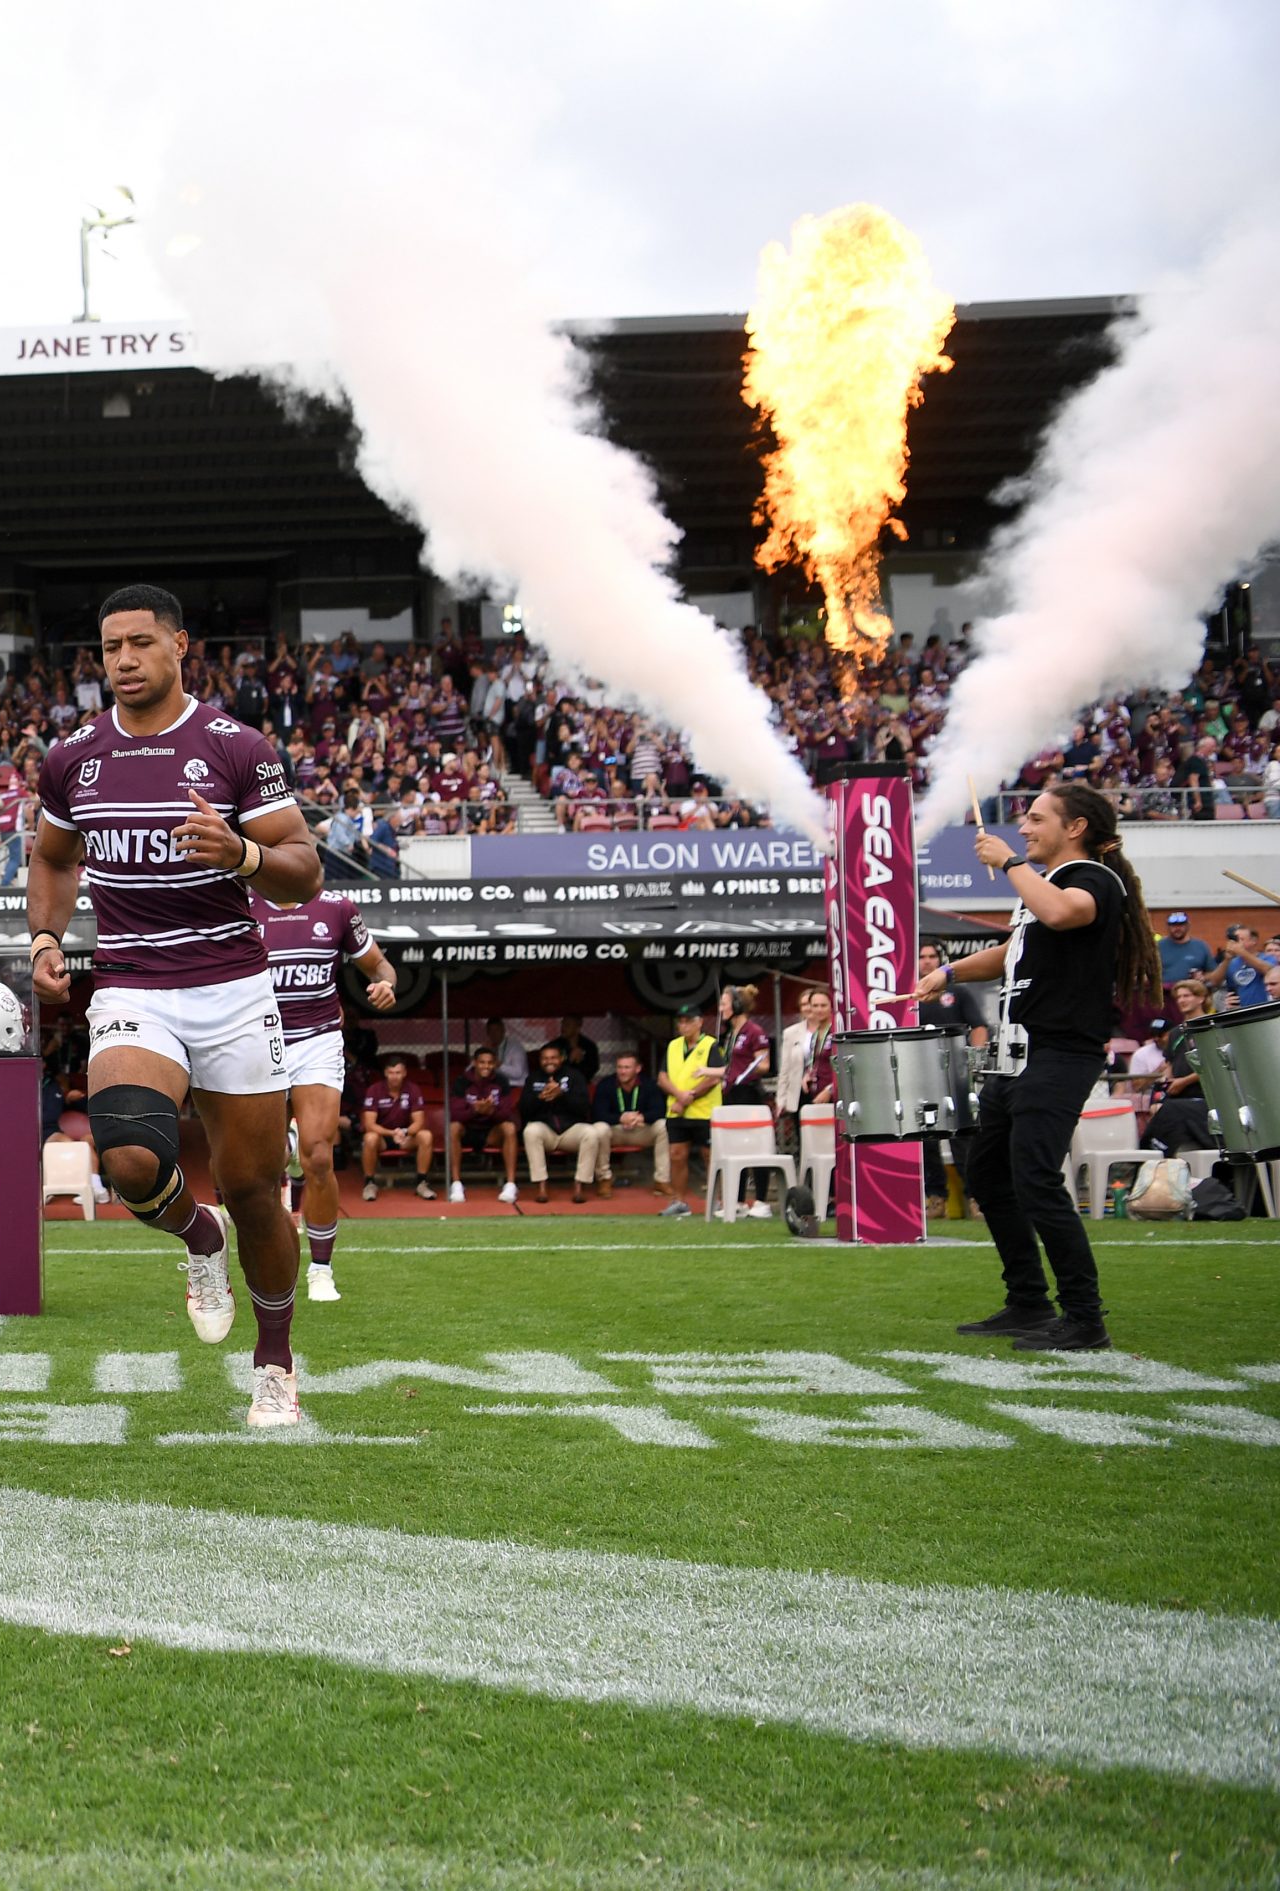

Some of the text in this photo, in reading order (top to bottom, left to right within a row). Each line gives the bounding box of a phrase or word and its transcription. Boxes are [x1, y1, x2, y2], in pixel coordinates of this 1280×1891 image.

[17, 335, 91, 360] JANE
[101, 333, 158, 356] TRY
[260, 776, 286, 797] and
[861, 792, 893, 888] SEA
[587, 842, 699, 871] SALON
[389, 886, 474, 903] BREWING
[480, 885, 515, 902] CO.
[553, 887, 567, 901] 4
[569, 884, 620, 901] PINES
[624, 881, 673, 898] PARK
[711, 879, 726, 895] 4
[728, 877, 781, 895] PINES
[432, 946, 444, 961] 4
[446, 945, 497, 961] PINES
[504, 944, 589, 960] BREWING
[595, 943, 630, 959] CO.
[673, 943, 686, 957] 4
[688, 943, 740, 958] PINES
[744, 941, 792, 957] PARK
